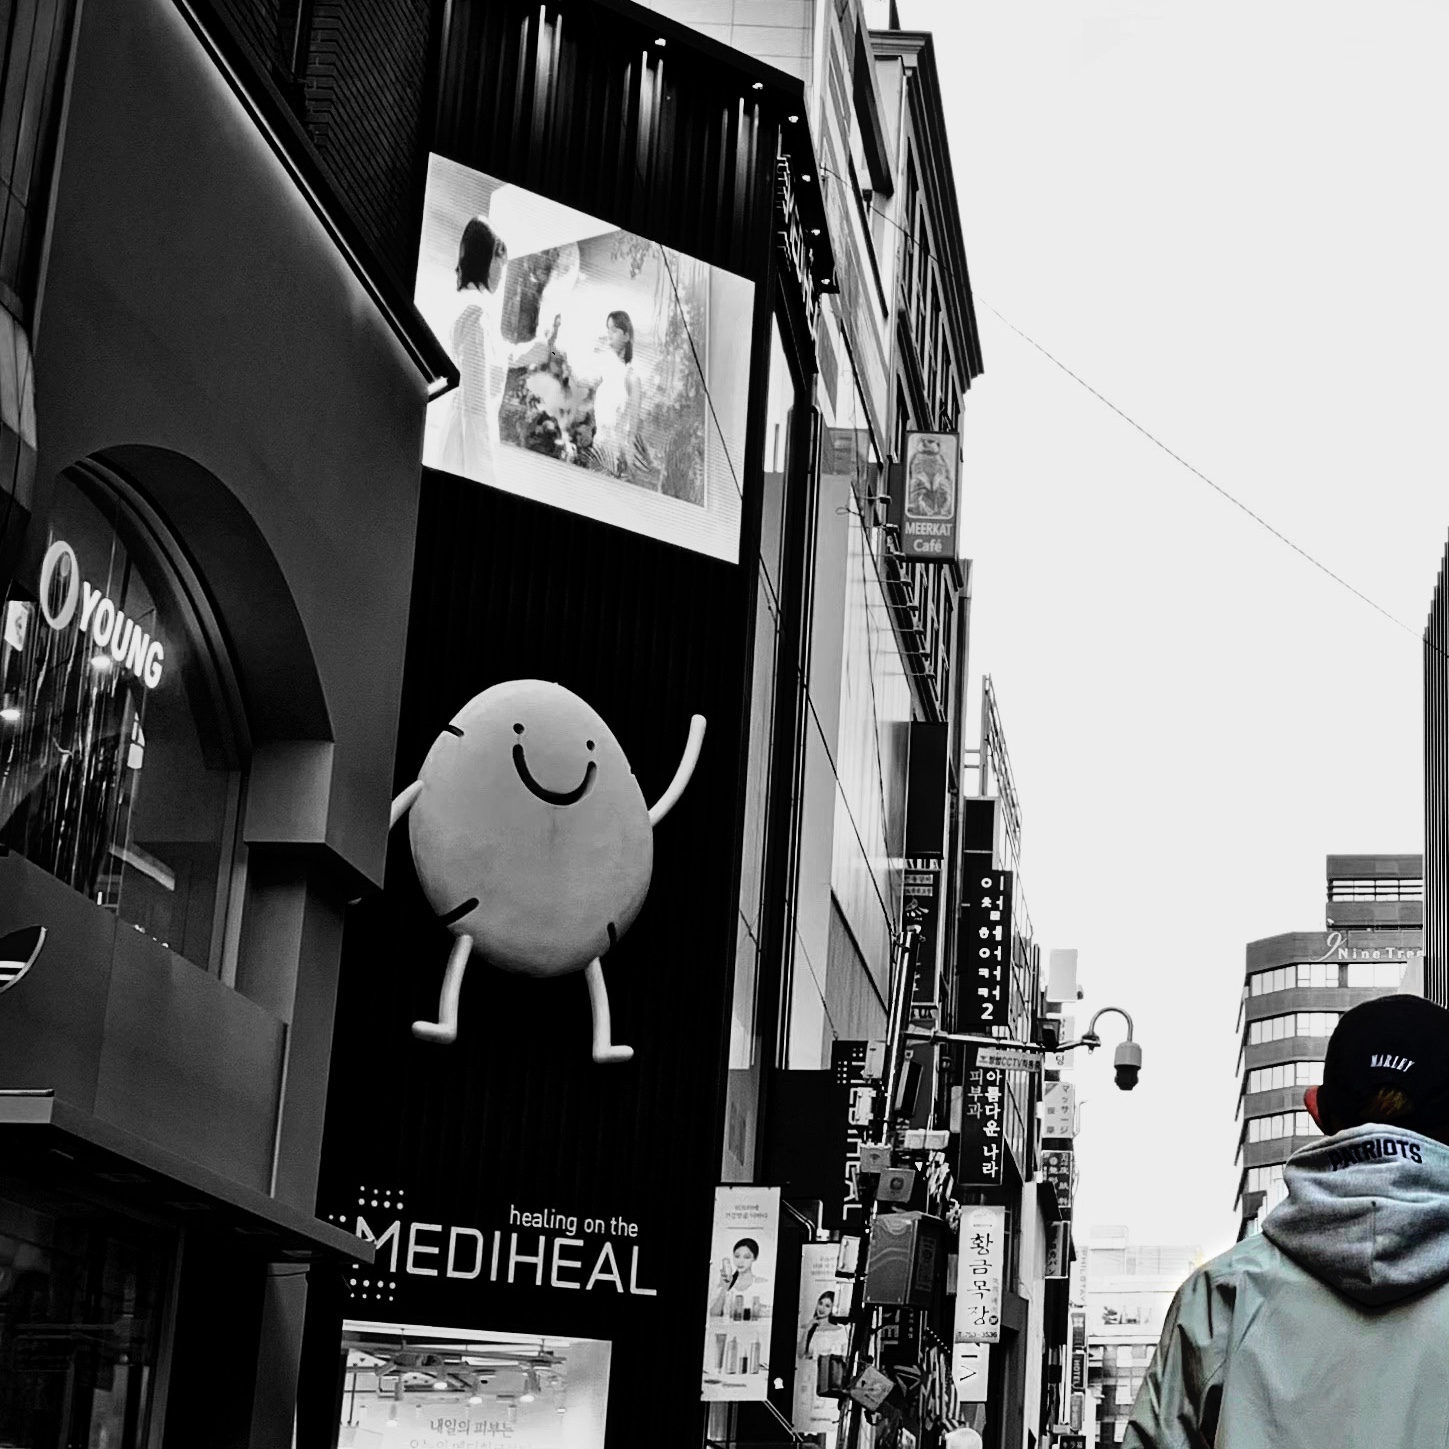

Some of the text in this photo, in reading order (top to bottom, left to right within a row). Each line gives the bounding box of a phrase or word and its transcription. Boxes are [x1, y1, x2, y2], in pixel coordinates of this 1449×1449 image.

[905, 522, 952, 535] MEERKAT
[80, 581, 164, 689] YOUNG
[966, 1069, 984, 1120] 피부과
[982, 1069, 1002, 1178] 아름다운 나라
[1328, 1139, 1423, 1172] PATRIOTS
[510, 1205, 639, 1237] healing on the
[353, 1216, 658, 1296] MEDIHEAL
[966, 1232, 995, 1326] 황금목장
[430, 1418, 515, 1438] 내일의 피부는
